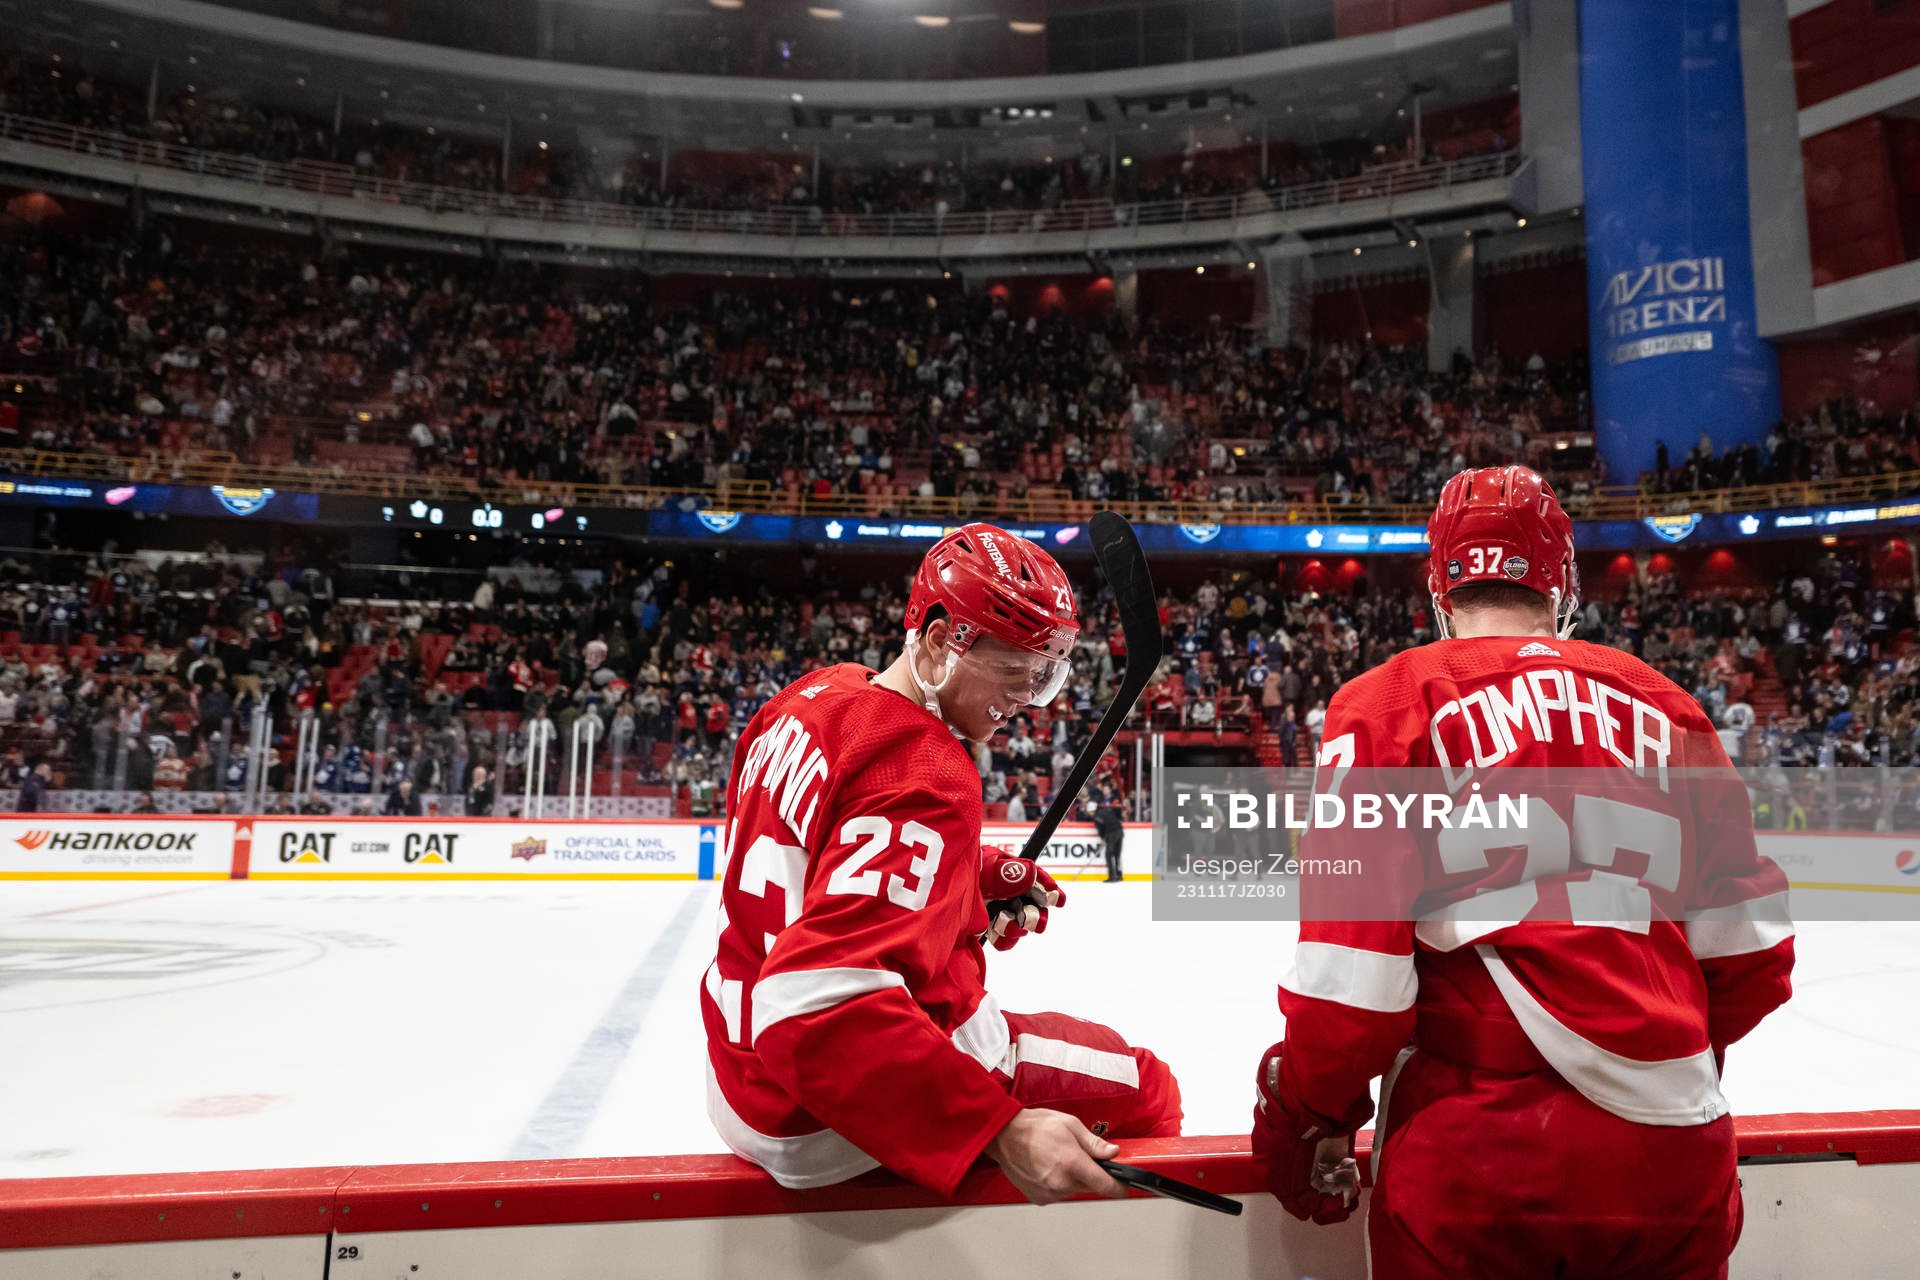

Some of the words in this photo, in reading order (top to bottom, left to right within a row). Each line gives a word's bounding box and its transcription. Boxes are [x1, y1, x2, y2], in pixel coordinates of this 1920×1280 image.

[1598, 256, 1725, 310] AVICII
[976, 532, 1011, 577] FASTENAL
[1468, 547, 1503, 574] 37
[1516, 648, 1561, 657] adidas
[1430, 669, 1671, 794] COMPHER
[1301, 732, 1356, 836] 7
[280, 832, 337, 863] CAT
[404, 833, 459, 863] CAT
[554, 850, 620, 861] TRADING
[624, 850, 676, 861] CARDS
[565, 837, 631, 848] OFFICIAL
[637, 837, 664, 848] NHL
[1022, 843, 1102, 858] ATION
[825, 815, 944, 912] 23
[337, 1246, 359, 1260] 29
